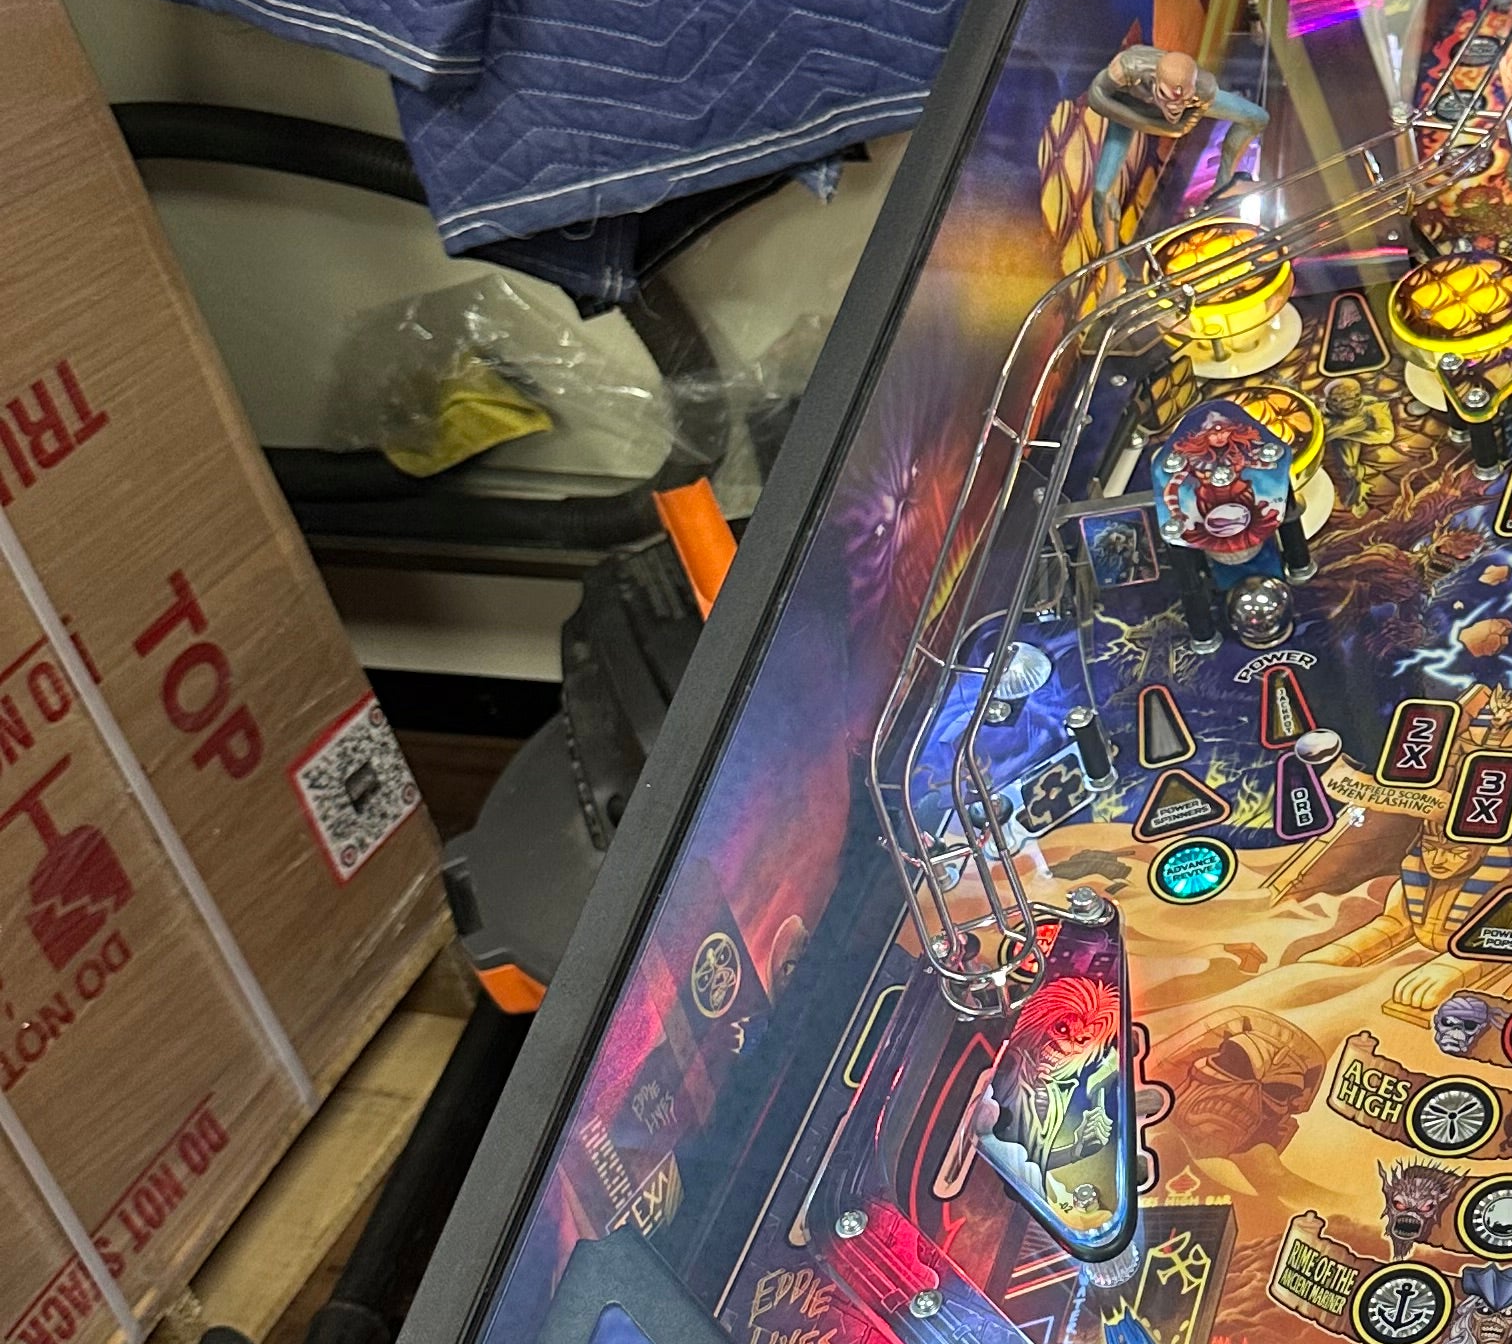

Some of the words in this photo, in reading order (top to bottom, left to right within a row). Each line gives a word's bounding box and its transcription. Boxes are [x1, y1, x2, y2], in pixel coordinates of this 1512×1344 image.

[131, 568, 265, 780] TOP
[1234, 650, 1318, 683] POWER
[1276, 687, 1294, 737] JACKPOT
[1157, 798, 1201, 817] POWER
[1291, 787, 1313, 827] ORB
[1327, 778, 1367, 802] WHEN
[1367, 792, 1434, 815] FLASHING
[1341, 776, 1396, 797] PLAYFIELD
[1399, 789, 1447, 809] SCORING
[1151, 804, 1212, 828] SPINNERS
[1166, 856, 1219, 876] ADVANCE
[1172, 865, 1215, 882] REVIVE
[75, 929, 133, 1001] DO
[1337, 1079, 1403, 1124] HIGH
[1344, 1059, 1412, 1103] ACES
[177, 1107, 229, 1176] DO
[118, 1161, 187, 1255] NOT
[1287, 1239, 1320, 1277] RIME
[1313, 1256, 1336, 1285] OF
[1330, 1261, 1359, 1296] THE
[748, 1268, 838, 1328] EDDIE
[1278, 1267, 1313, 1299] ANCIENT
[1308, 1284, 1347, 1315] MARINER
